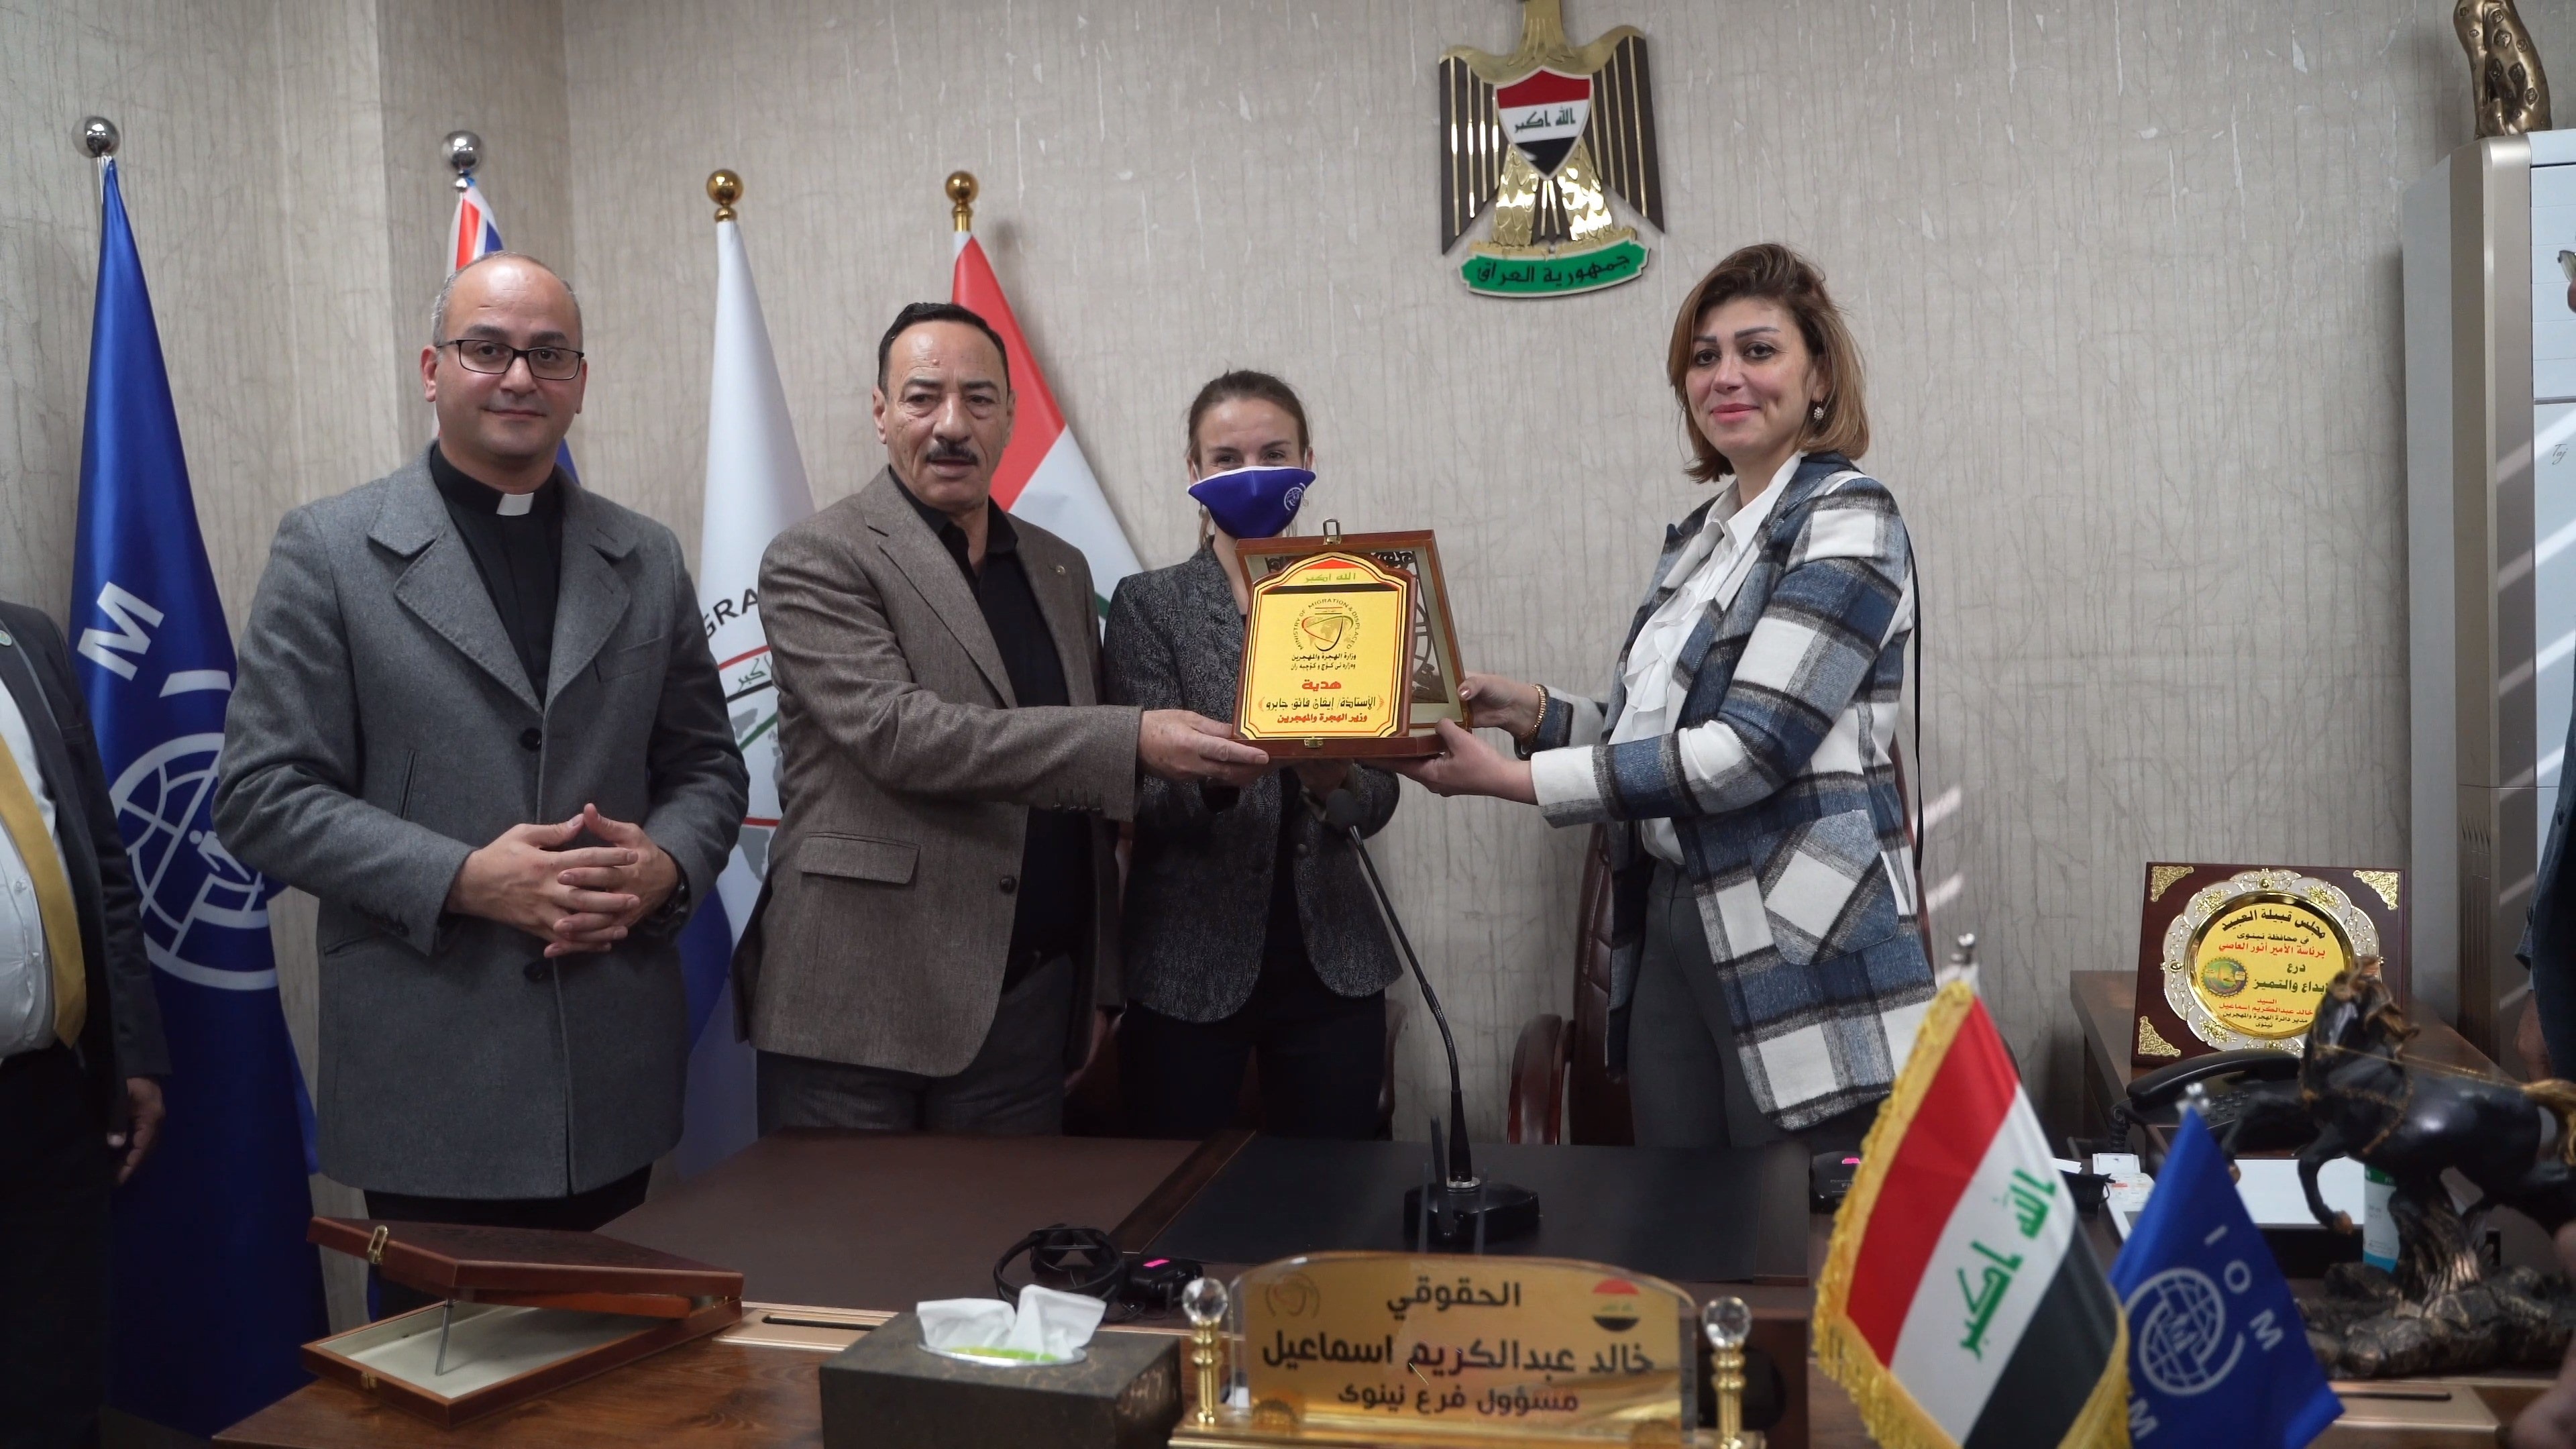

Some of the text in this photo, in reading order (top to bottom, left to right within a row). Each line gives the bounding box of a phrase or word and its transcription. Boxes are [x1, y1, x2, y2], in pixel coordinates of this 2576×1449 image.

[1477, 255, 1630, 286] جمهورية العراق
[1293, 618, 1303, 650] MINISTRY
[1308, 598, 1349, 609] MIGRATION
[1322, 652, 1342, 661] الهجرة
[1344, 652, 1356, 660] وزارة
[1301, 680, 1342, 692] هدية
[1266, 697, 1288, 711] جابرو
[1319, 713, 1347, 723] الهجرة
[1348, 712, 1367, 723] وزير
[2222, 909, 2326, 939] مجلس قبيلة العبيد
[2267, 933, 2297, 944] محافظة
[2287, 963, 2306, 974] درع
[2253, 979, 2298, 993] والتميز
[1387, 1275, 1520, 1321] الحقوقي
[1263, 1330, 1393, 1370] اسماعيل
[1589, 1342, 1654, 1374] خالد
[1416, 1383, 1466, 1415] فرع
[1477, 1385, 1579, 1415] مسؤول
